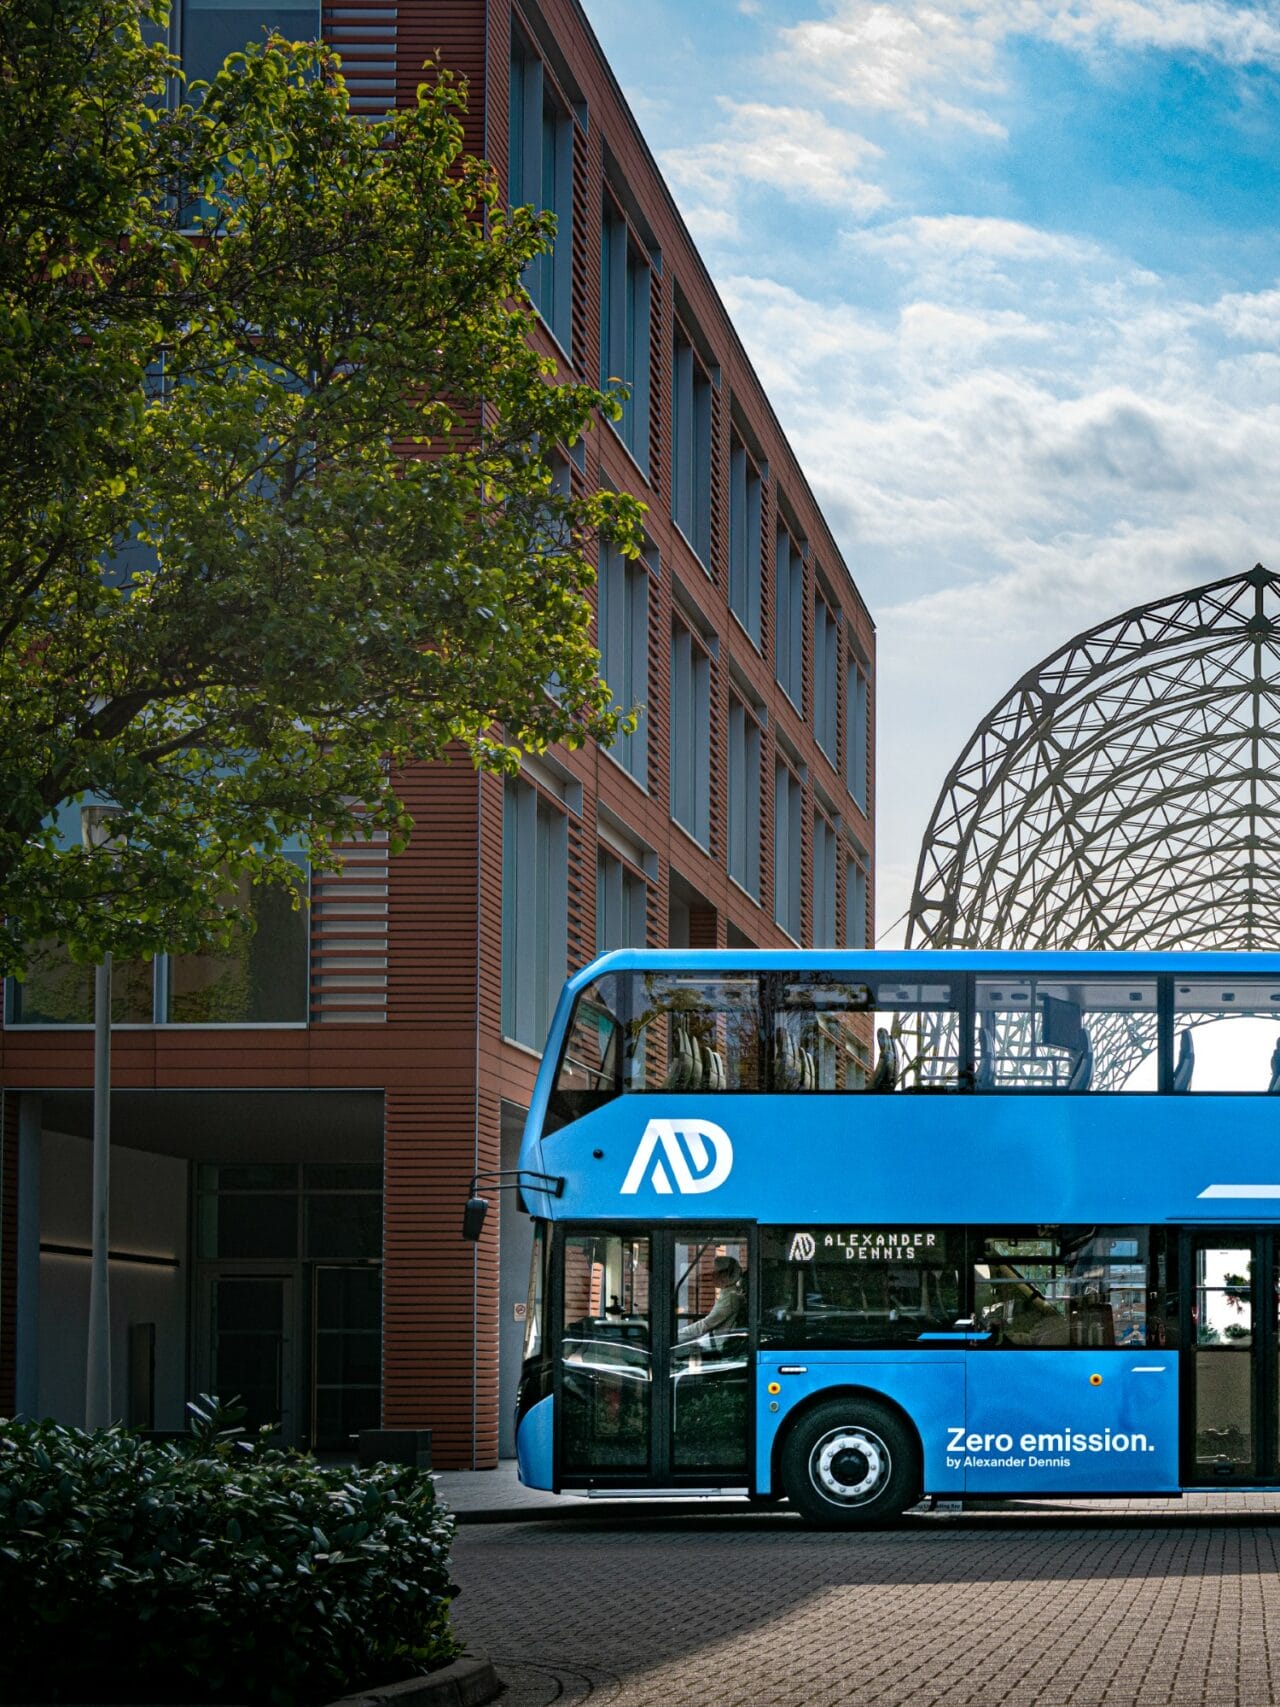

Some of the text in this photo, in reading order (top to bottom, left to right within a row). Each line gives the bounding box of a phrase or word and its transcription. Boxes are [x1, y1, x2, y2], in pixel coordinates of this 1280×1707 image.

[824, 1234, 936, 1246] ALEXANDER
[846, 1247, 915, 1259] DENNIS
[947, 1427, 1155, 1452] Zero emission.
[946, 1456, 1070, 1469] by Alexander Dennis
